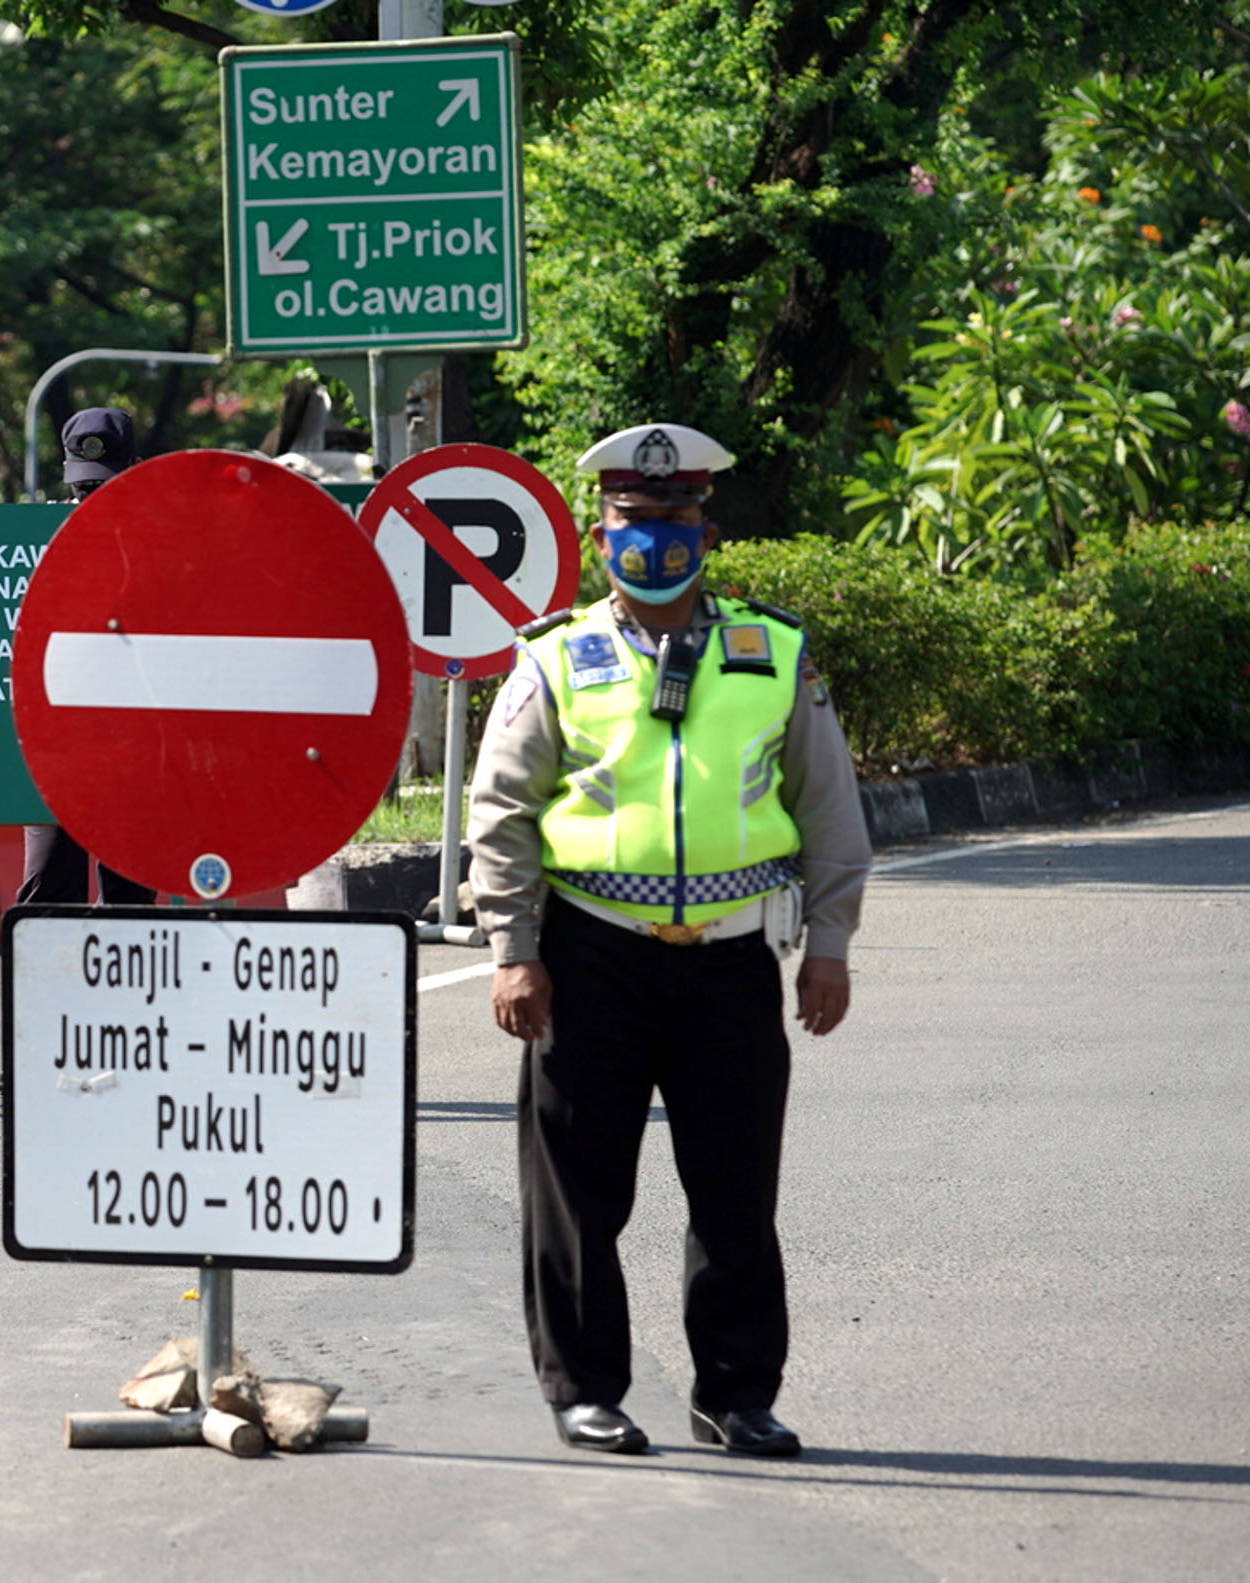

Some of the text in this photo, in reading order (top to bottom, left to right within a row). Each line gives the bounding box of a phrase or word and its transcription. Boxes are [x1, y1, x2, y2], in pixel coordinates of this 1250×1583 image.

[249, 85, 394, 125] Sunter
[248, 143, 497, 186] Kemayoran
[328, 217, 498, 269] Tj.Priok
[274, 279, 504, 321] ol.Cawang
[423, 498, 526, 637] P
[83, 930, 182, 1005] Ganjil
[234, 937, 339, 1007] Genap
[54, 1014, 170, 1072] Jumat
[228, 1013, 366, 1093] Minggu
[157, 1092, 264, 1154] Pukul
[87, 1170, 187, 1228] 12.00
[245, 1176, 349, 1235] 18.00
